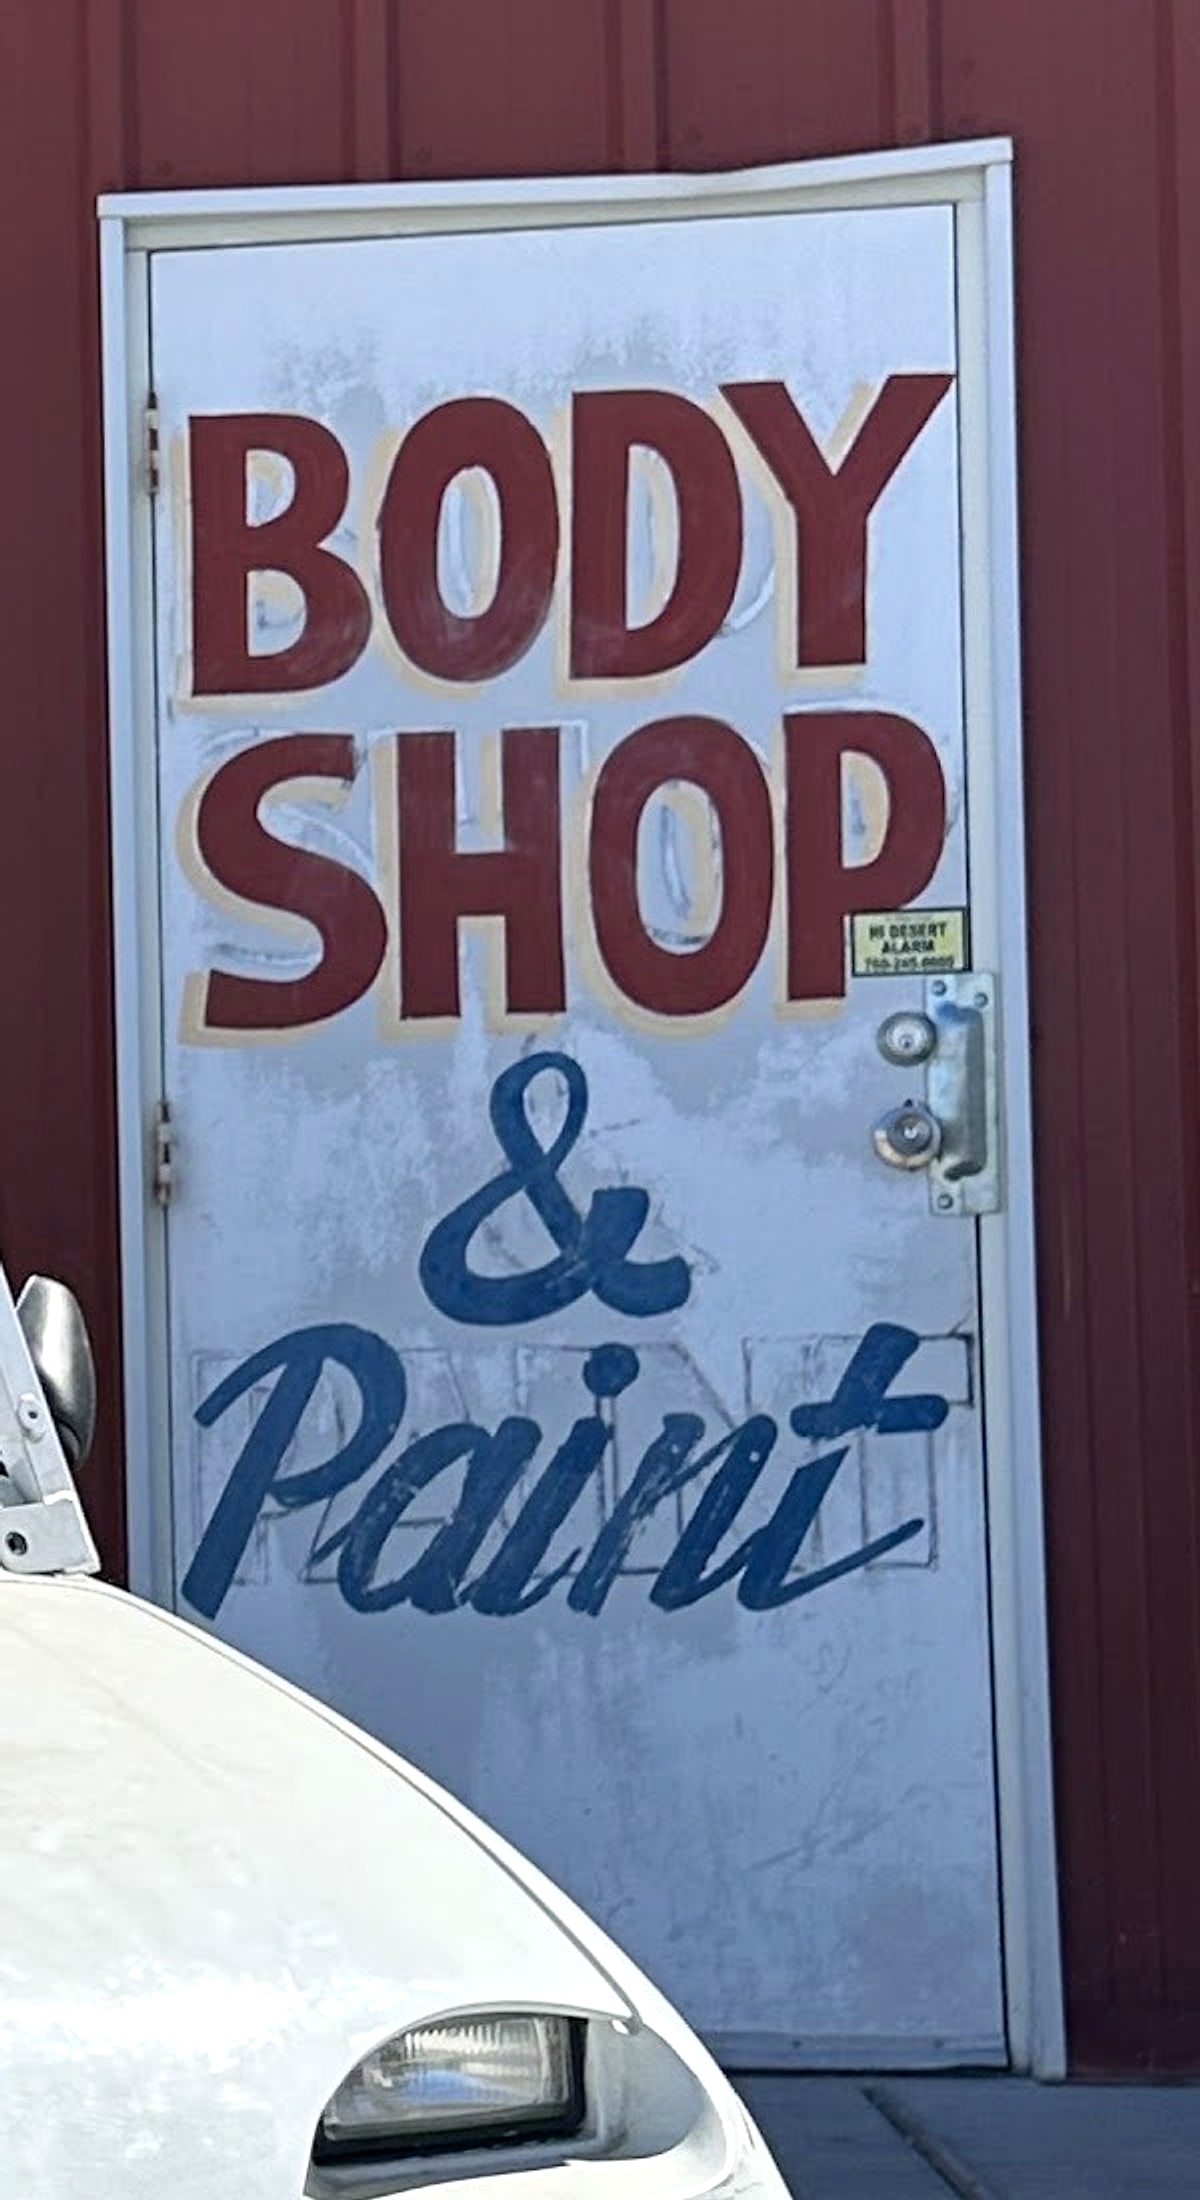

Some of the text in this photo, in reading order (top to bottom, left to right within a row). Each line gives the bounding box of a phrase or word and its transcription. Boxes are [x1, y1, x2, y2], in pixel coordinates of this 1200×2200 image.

[187, 373, 956, 697] BODY
[196, 710, 947, 1030] SHOP
[882, 939, 935, 954] ALARM
[889, 921, 947, 939] DESERT
[418, 1050, 692, 1327] &
[180, 1322, 950, 1622] Paint
